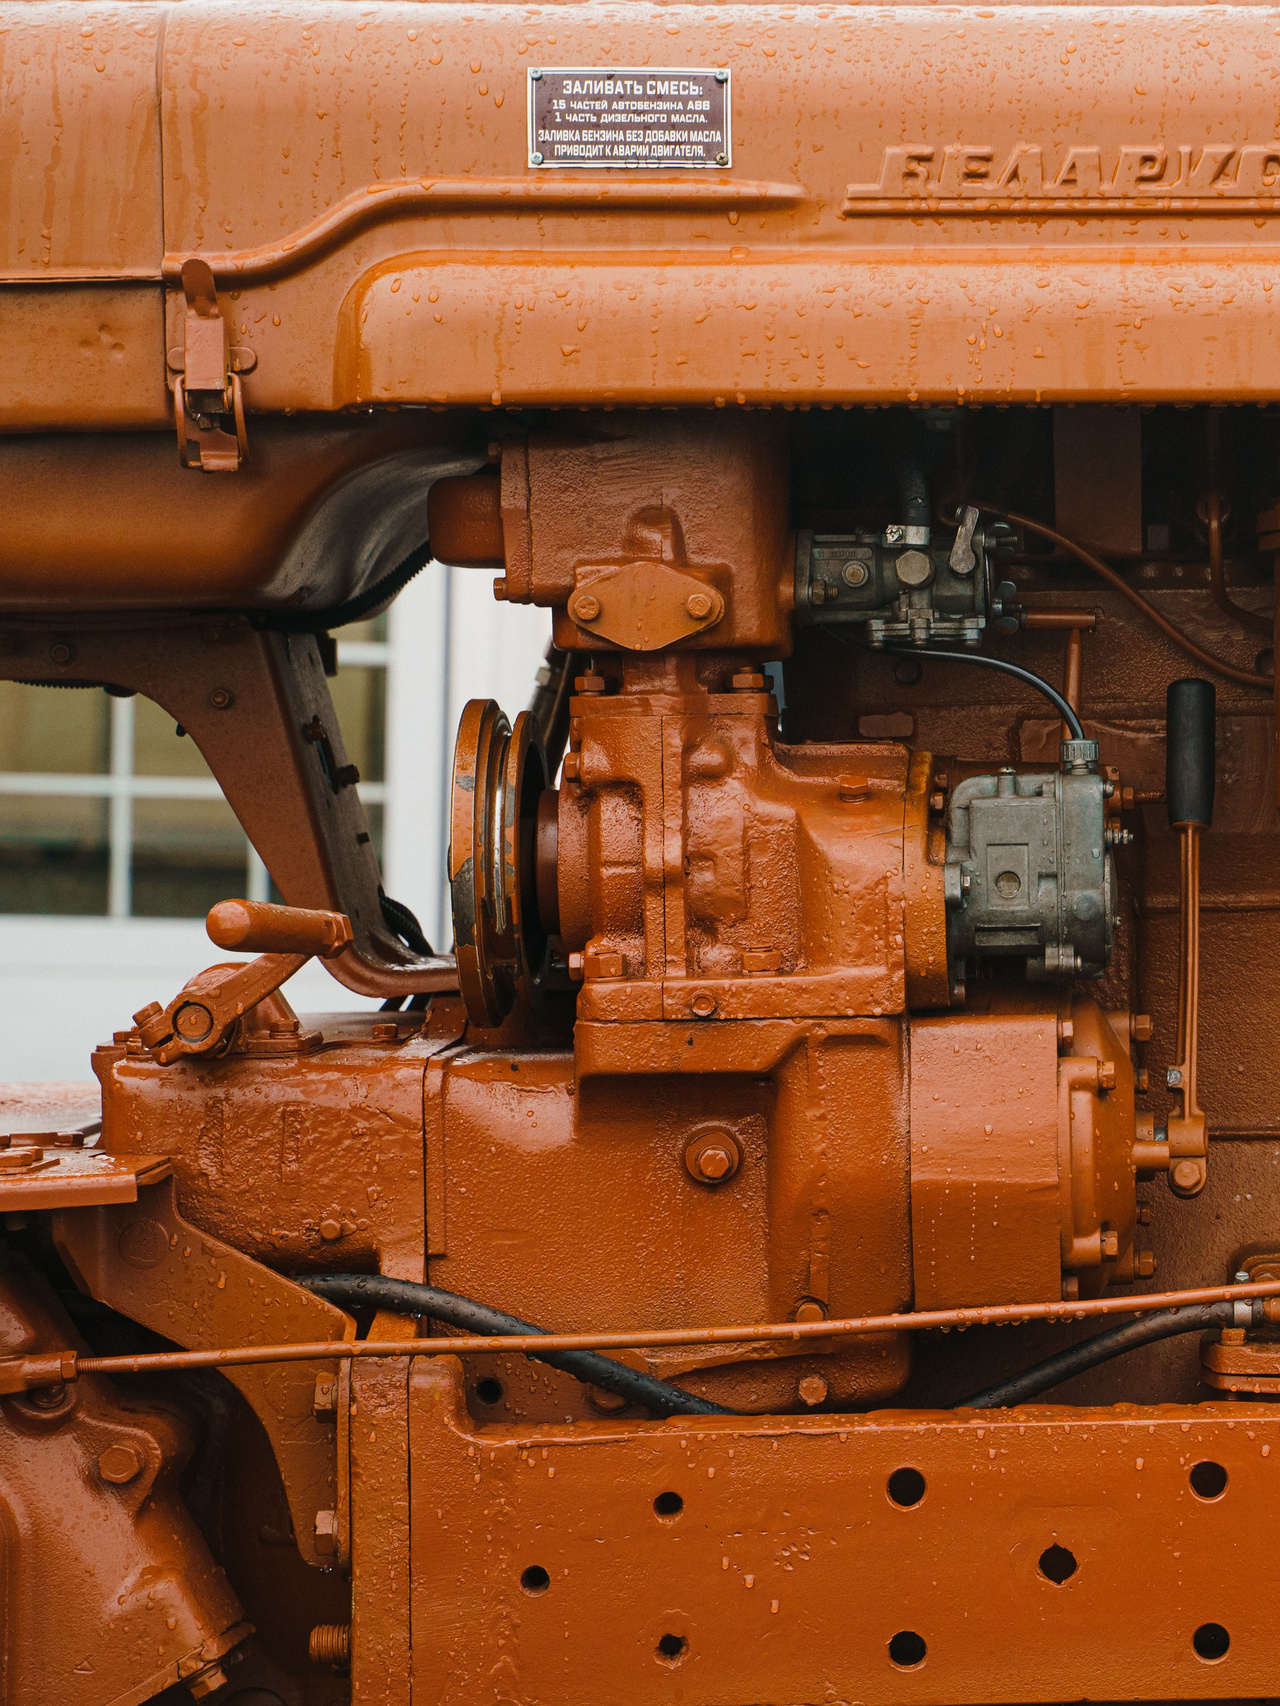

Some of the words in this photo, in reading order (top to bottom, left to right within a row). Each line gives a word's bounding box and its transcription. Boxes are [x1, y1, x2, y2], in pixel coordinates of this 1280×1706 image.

[562, 80, 643, 95] ЗАЛИВАТЬ
[646, 80, 703, 96] СМЕСЬ:
[552, 99, 567, 110] 15
[570, 100, 608, 110] ЧАСТЕЙ
[611, 101, 684, 111] АВТОБЕНЗИНА
[555, 112, 562, 122] 1
[565, 113, 598, 123] ЧАСТЬ
[600, 113, 668, 124] ДИЗЕЛЬНОГО
[671, 113, 708, 123] МАСЛА.
[538, 129, 581, 142] ЗАЛИВКА
[582, 130, 625, 142] БЕНЗИНА
[626, 130, 644, 142] БЕЗ
[645, 130, 689, 144] ДОБАВКИ
[689, 130, 722, 142] МАСЛА
[554, 144, 604, 158] ПРИВОДИТ
[605, 144, 611, 156] К
[612, 145, 649, 157] АВАРИИ
[650, 145, 706, 158] ДВИГАТЕЛЯ.
